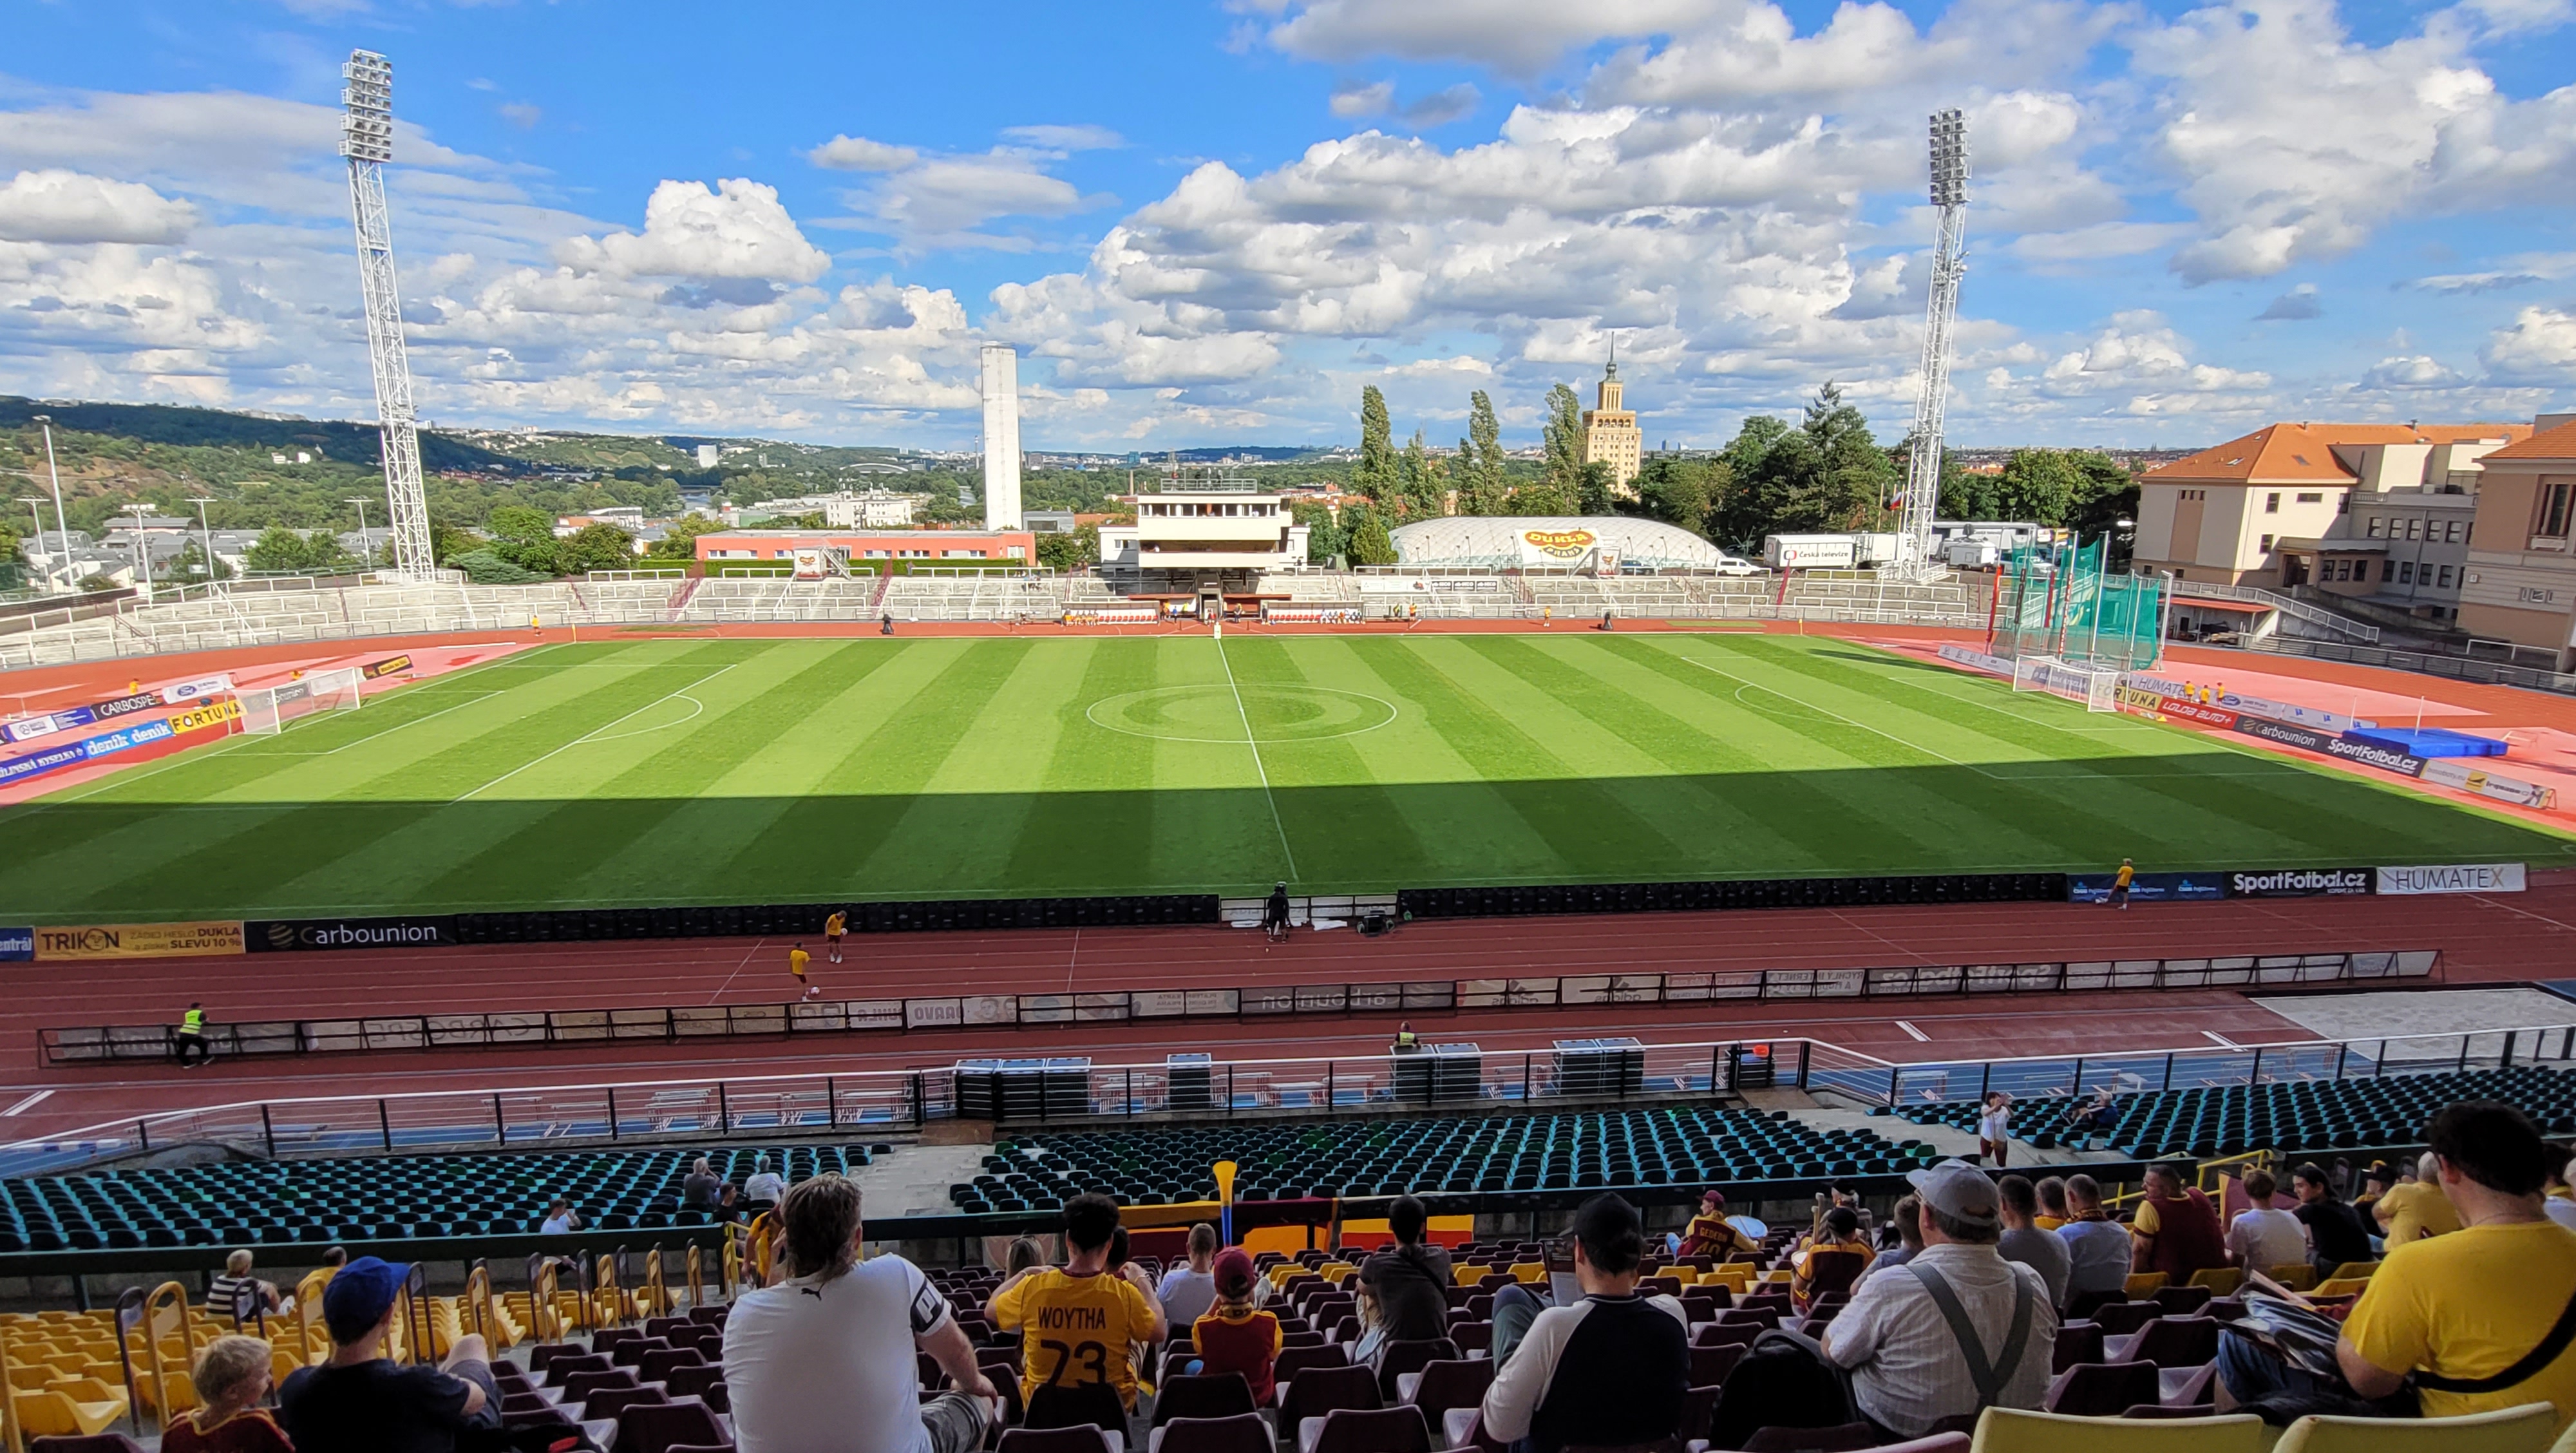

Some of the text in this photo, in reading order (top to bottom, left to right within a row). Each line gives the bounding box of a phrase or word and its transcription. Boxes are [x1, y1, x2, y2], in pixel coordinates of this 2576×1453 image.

[1529, 533, 1588, 543] DUKLA
[2095, 684, 2157, 708] FORTUNA
[2138, 677, 2191, 699] HUMATE
[100, 695, 158, 716] CARBOSPE
[173, 703, 242, 732] FORTUNA
[134, 723, 171, 743] deník
[2255, 723, 2316, 747] Carbounion
[87, 734, 129, 755] deník
[2327, 739, 2418, 770] SportFotbal.cz
[2233, 871, 2366, 894] SportFotbal.cz
[2396, 868, 2504, 890] HUMATEX
[197, 927, 241, 937] DUKLA
[300, 923, 437, 945] Carbounion
[171, 938, 211, 949] SLEVU
[214, 938, 226, 947] 10
[1038, 1306, 1106, 1329] WOYTHA
[1041, 1340, 1107, 1385] 73
